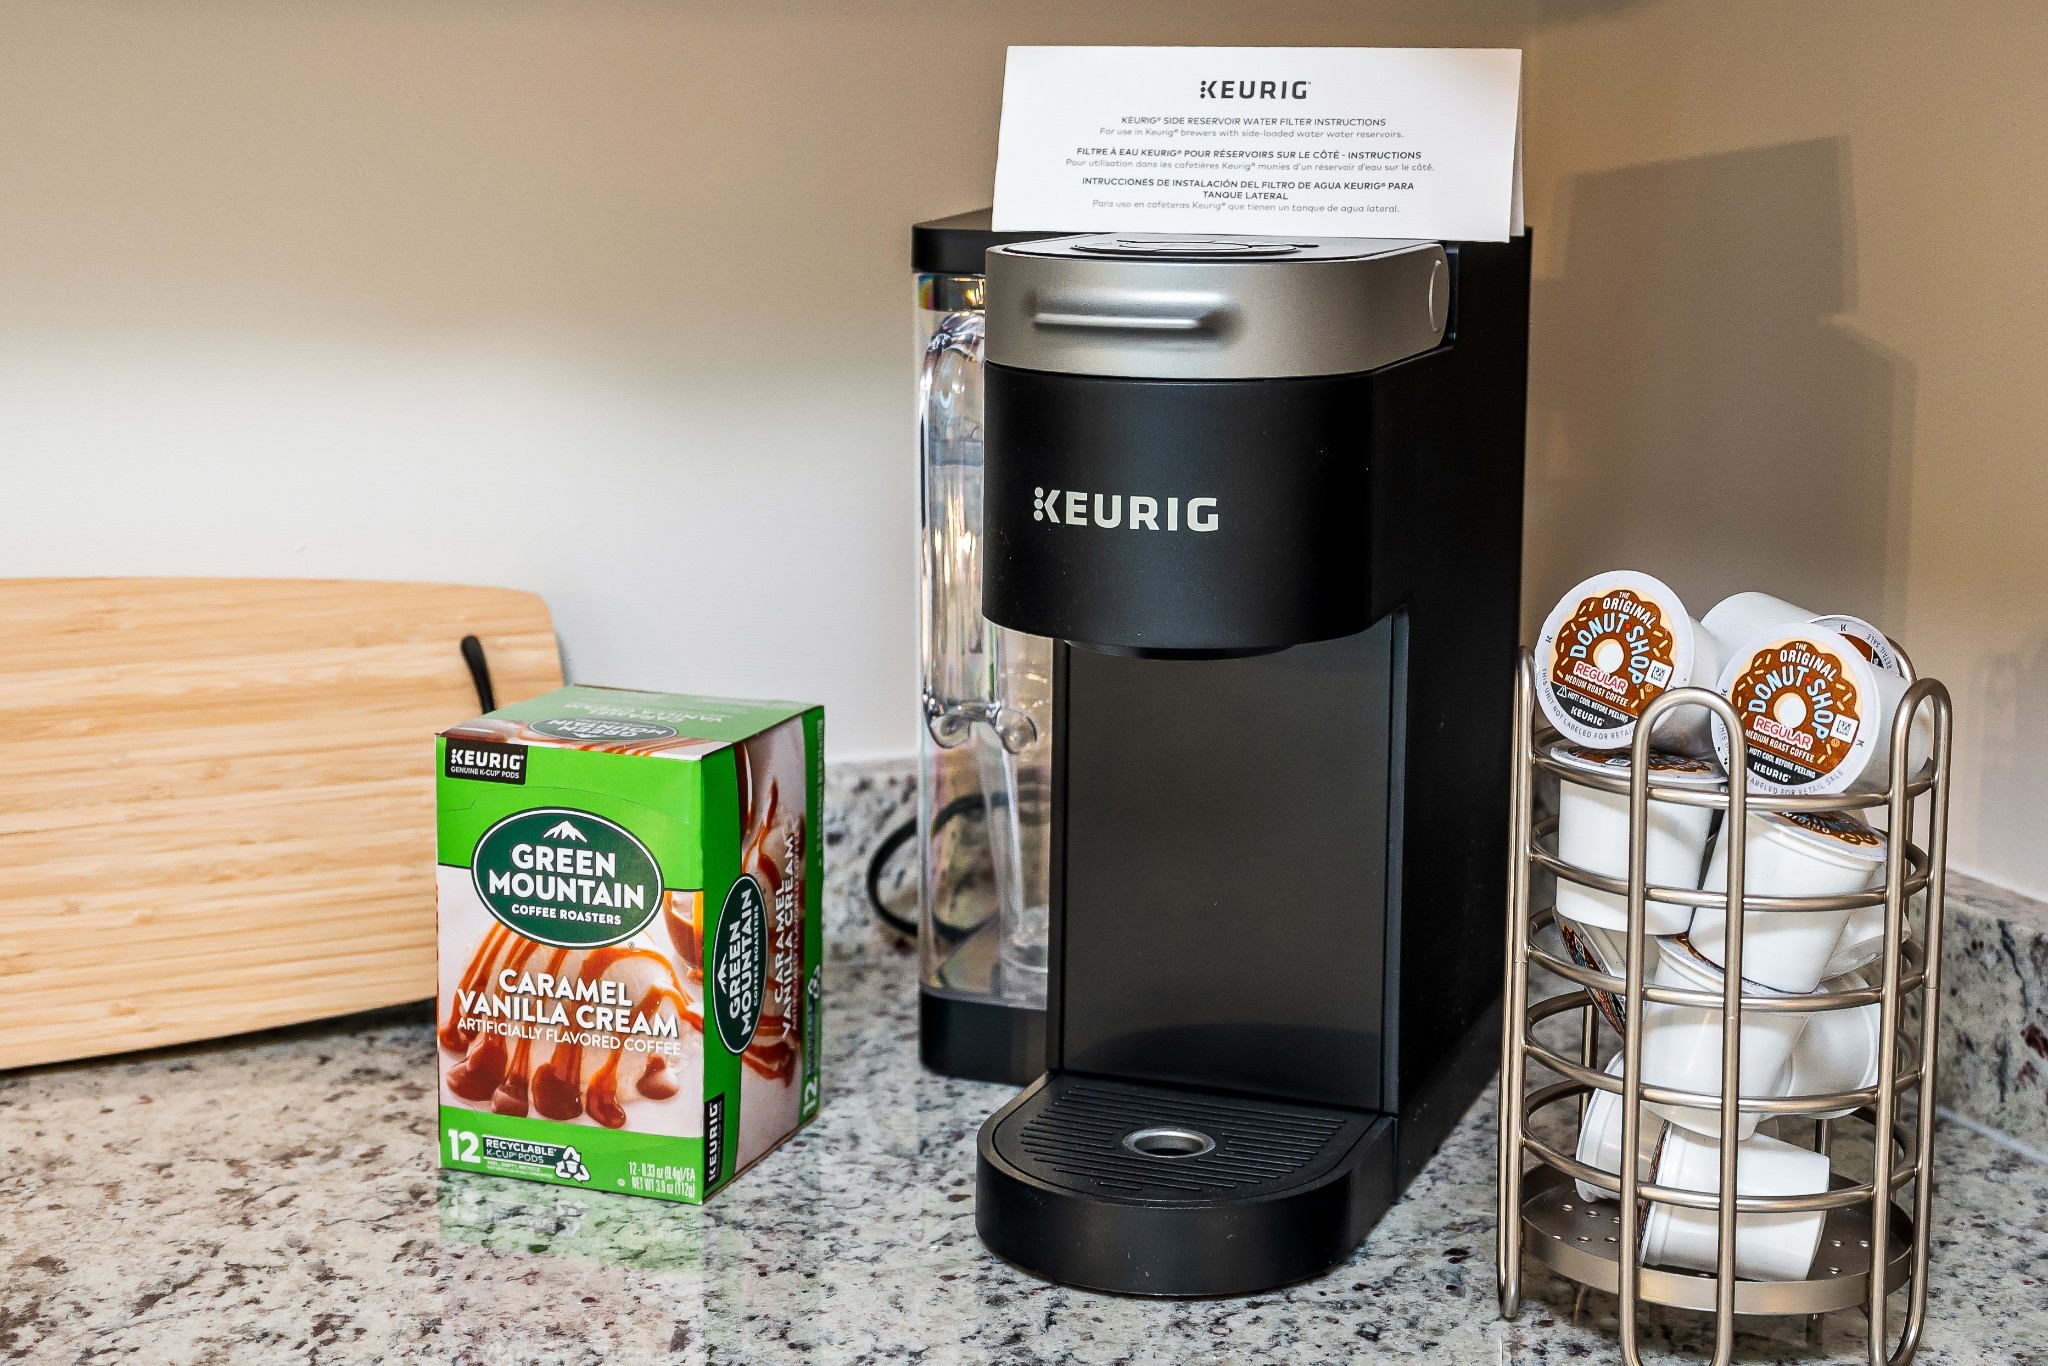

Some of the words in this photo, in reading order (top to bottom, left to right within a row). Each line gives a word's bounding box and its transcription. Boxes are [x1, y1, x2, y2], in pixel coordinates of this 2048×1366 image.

[1200, 80, 1307, 100] KEURIG
[1099, 127, 1115, 135] For
[1134, 128, 1143, 136] in
[1180, 129, 1217, 137] brewers
[1219, 129, 1239, 137] with
[1241, 129, 1294, 138] side-loaded
[1297, 130, 1324, 138] water
[1356, 131, 1404, 139] reservoirs.
[1163, 117, 1185, 125] SIDE
[1187, 117, 1241, 126] RESERVOIR
[1243, 117, 1278, 126] WATER
[1280, 118, 1313, 126] FILTER
[1314, 118, 1387, 127] INSTRUCTIONS
[1065, 158, 1086, 166] Pour
[1088, 158, 1133, 167] utilisation
[1135, 160, 1157, 168] dans
[1159, 160, 1172, 169] les
[1174, 161, 1220, 170] cafetières
[1258, 163, 1291, 171] munies
[1314, 162, 1354, 171] réservoir
[1401, 163, 1410, 171] le
[1076, 147, 1108, 156] FILTRE
[1111, 146, 1117, 156] À
[1119, 148, 1139, 156] EAU
[1184, 149, 1211, 158] POUR
[1213, 148, 1274, 158] RÉSERVOIRS
[1276, 151, 1296, 159] SUR
[1299, 151, 1310, 159] LE
[1313, 149, 1339, 160] CÔTÉ
[1347, 151, 1422, 160] INSTRUCTIONS
[1082, 177, 1154, 186] INTRUCCIONES
[1156, 179, 1170, 187] DE
[1172, 178, 1238, 188] INSTALACIÓN
[1240, 180, 1260, 188] DEL
[1261, 181, 1296, 189] FILTRO
[1298, 181, 1311, 189] DE
[1313, 181, 1342, 190] AGUA
[1388, 182, 1414, 190] PARA
[1202, 191, 1243, 200] TANQUE
[1245, 192, 1289, 200] LATERAL
[1092, 200, 1114, 208] Para
[1146, 201, 1190, 209] cafeteras
[1227, 203, 1245, 211] que
[1247, 203, 1276, 211] tienen
[1292, 204, 1325, 213] tanque
[1327, 204, 1339, 212] de
[1340, 205, 1364, 213] agua
[1366, 205, 1400, 213] lateral.
[1033, 486, 1219, 532] KEURIG
[1618, 591, 1630, 600] THE
[1602, 597, 1656, 629] ORIGINAL
[1569, 612, 1629, 659] DONUT
[1625, 625, 1650, 685] SHOP
[1795, 642, 1807, 650] THE
[1865, 633, 1881, 648] SALE
[1575, 662, 1627, 692] REGULAR
[1779, 649, 1838, 682] ORIGINAL
[1564, 674, 1588, 689] MEDIUM
[1586, 682, 1605, 697] ROAST
[1605, 691, 1629, 708] COFFEE
[1748, 664, 1809, 713] DONUT
[1806, 678, 1835, 740] SHOP
[1544, 687, 1554, 705] UNIT
[1552, 705, 1564, 718] NOT
[1563, 718, 1592, 738] LABELED
[1593, 732, 1608, 740] FOR
[1611, 728, 1632, 739] RETAI
[1570, 705, 1604, 726] KEURIG
[1579, 695, 1591, 706] COOL
[1591, 700, 1609, 715] BEFORE
[1608, 707, 1629, 724] PEELING
[547, 719, 668, 735] MOUNTAIN
[556, 725, 638, 736] GREEN
[1755, 717, 1811, 748] REGULAR
[451, 748, 523, 770] KEURIG
[1745, 729, 1769, 745] MEDIUM
[1769, 738, 1790, 753] ROAST
[1789, 748, 1815, 763] COFFEE
[450, 765, 478, 775] GENUINE
[501, 770, 520, 779] PODS
[1753, 761, 1790, 783] KEURIG
[1761, 752, 1775, 763] COOL
[1774, 757, 1794, 771] BEFORE
[1794, 763, 1816, 779] PEELING
[1825, 769, 1844, 786] SALE
[511, 843, 616, 879] GREEN
[488, 868, 645, 910] MOUNTAIN
[784, 834, 794, 928] CREAM
[511, 904, 557, 919] COFFEE
[559, 909, 622, 926] ROASTERS
[775, 886, 785, 1004] CARAMEL
[729, 919, 742, 1020] GREEN
[741, 888, 753, 1036] MOUNTAIN
[498, 968, 633, 1007] CARAMEL
[782, 931, 793, 1039] VANILLA
[457, 988, 570, 1028] VANILLA
[575, 1004, 679, 1038] CREAM
[457, 1016, 543, 1041] ARTIFICIALLY
[545, 1028, 621, 1051] FLAVORED
[623, 1037, 682, 1056] COFFEE
[802, 1076, 819, 1115] 12
[447, 1129, 481, 1164] 12
[708, 1102, 719, 1183] KEURIG
[518, 1153, 545, 1164] PODS
[628, 1161, 637, 1176] 12
[641, 1163, 656, 1178] 0.33
[656, 1167, 664, 1179] oz
[631, 1176, 644, 1190] NET
[644, 1178, 655, 1192] WT
[655, 1179, 666, 1194] 3.9
[666, 1183, 674, 1195] oz
